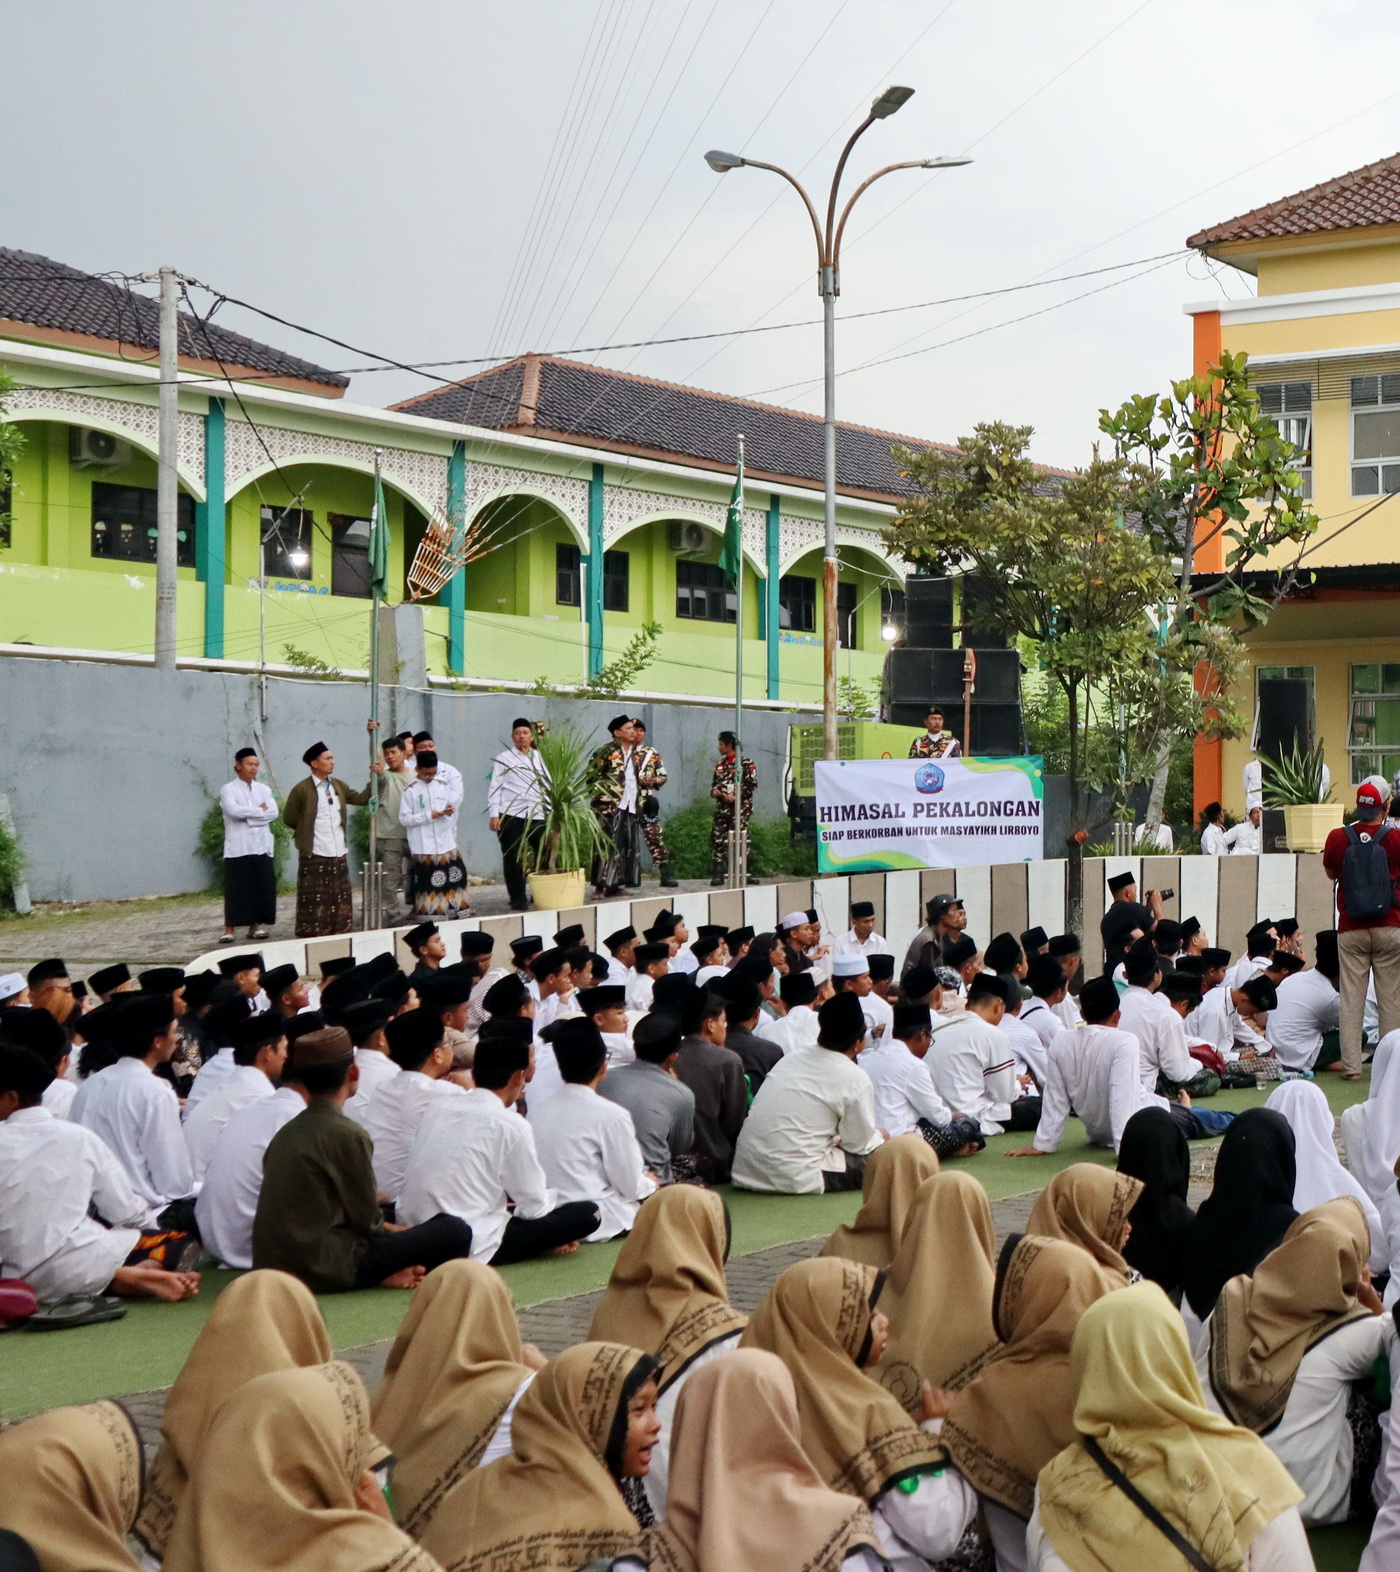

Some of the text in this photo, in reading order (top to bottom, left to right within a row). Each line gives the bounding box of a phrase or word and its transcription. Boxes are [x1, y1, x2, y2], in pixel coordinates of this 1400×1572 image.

[819, 800, 1041, 823] HIMASAL PEKALONGAN
[821, 825, 1040, 841] SIAP BERKORBAN UNTUK MASYAYIKH LIRBOYO
